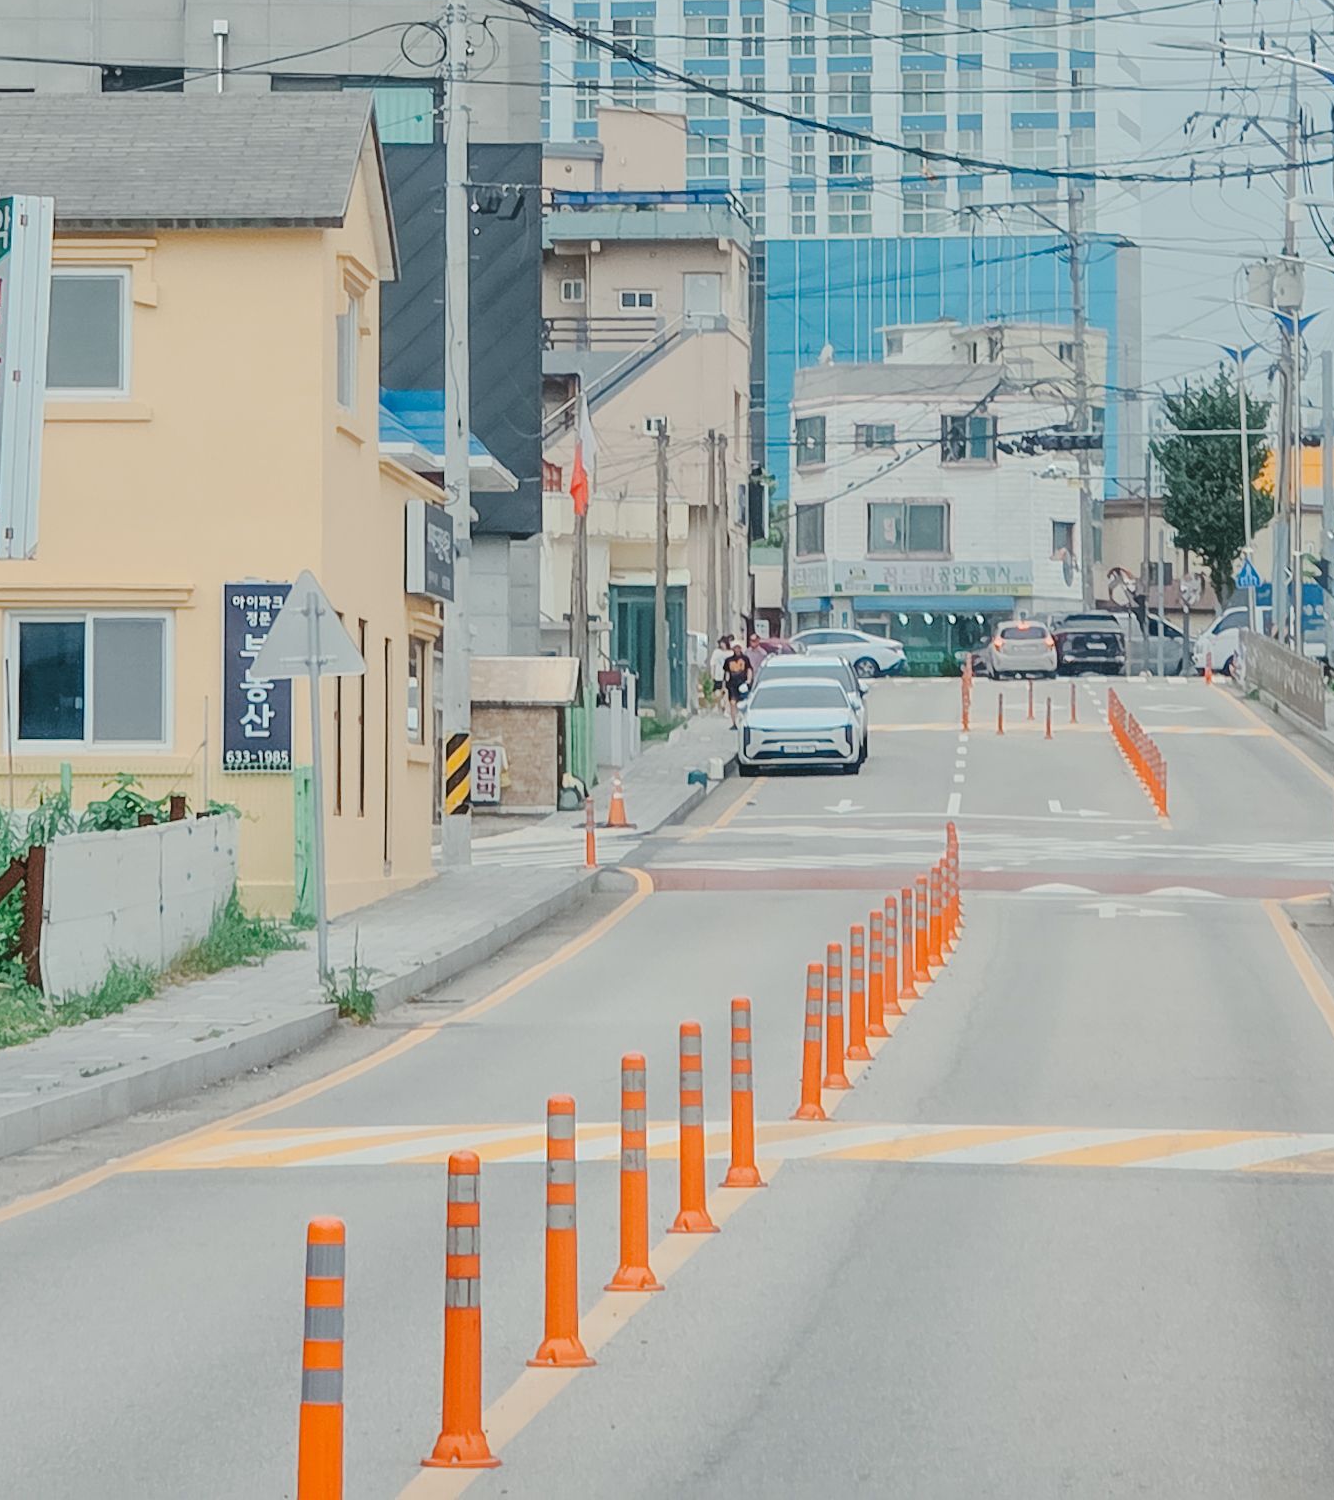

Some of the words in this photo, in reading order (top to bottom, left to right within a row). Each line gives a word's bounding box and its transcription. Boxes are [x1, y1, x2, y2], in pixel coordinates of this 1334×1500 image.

[232, 595, 284, 610] 아이파크
[246, 611, 271, 627] 정문
[226, 750, 289, 764] 633-1985
